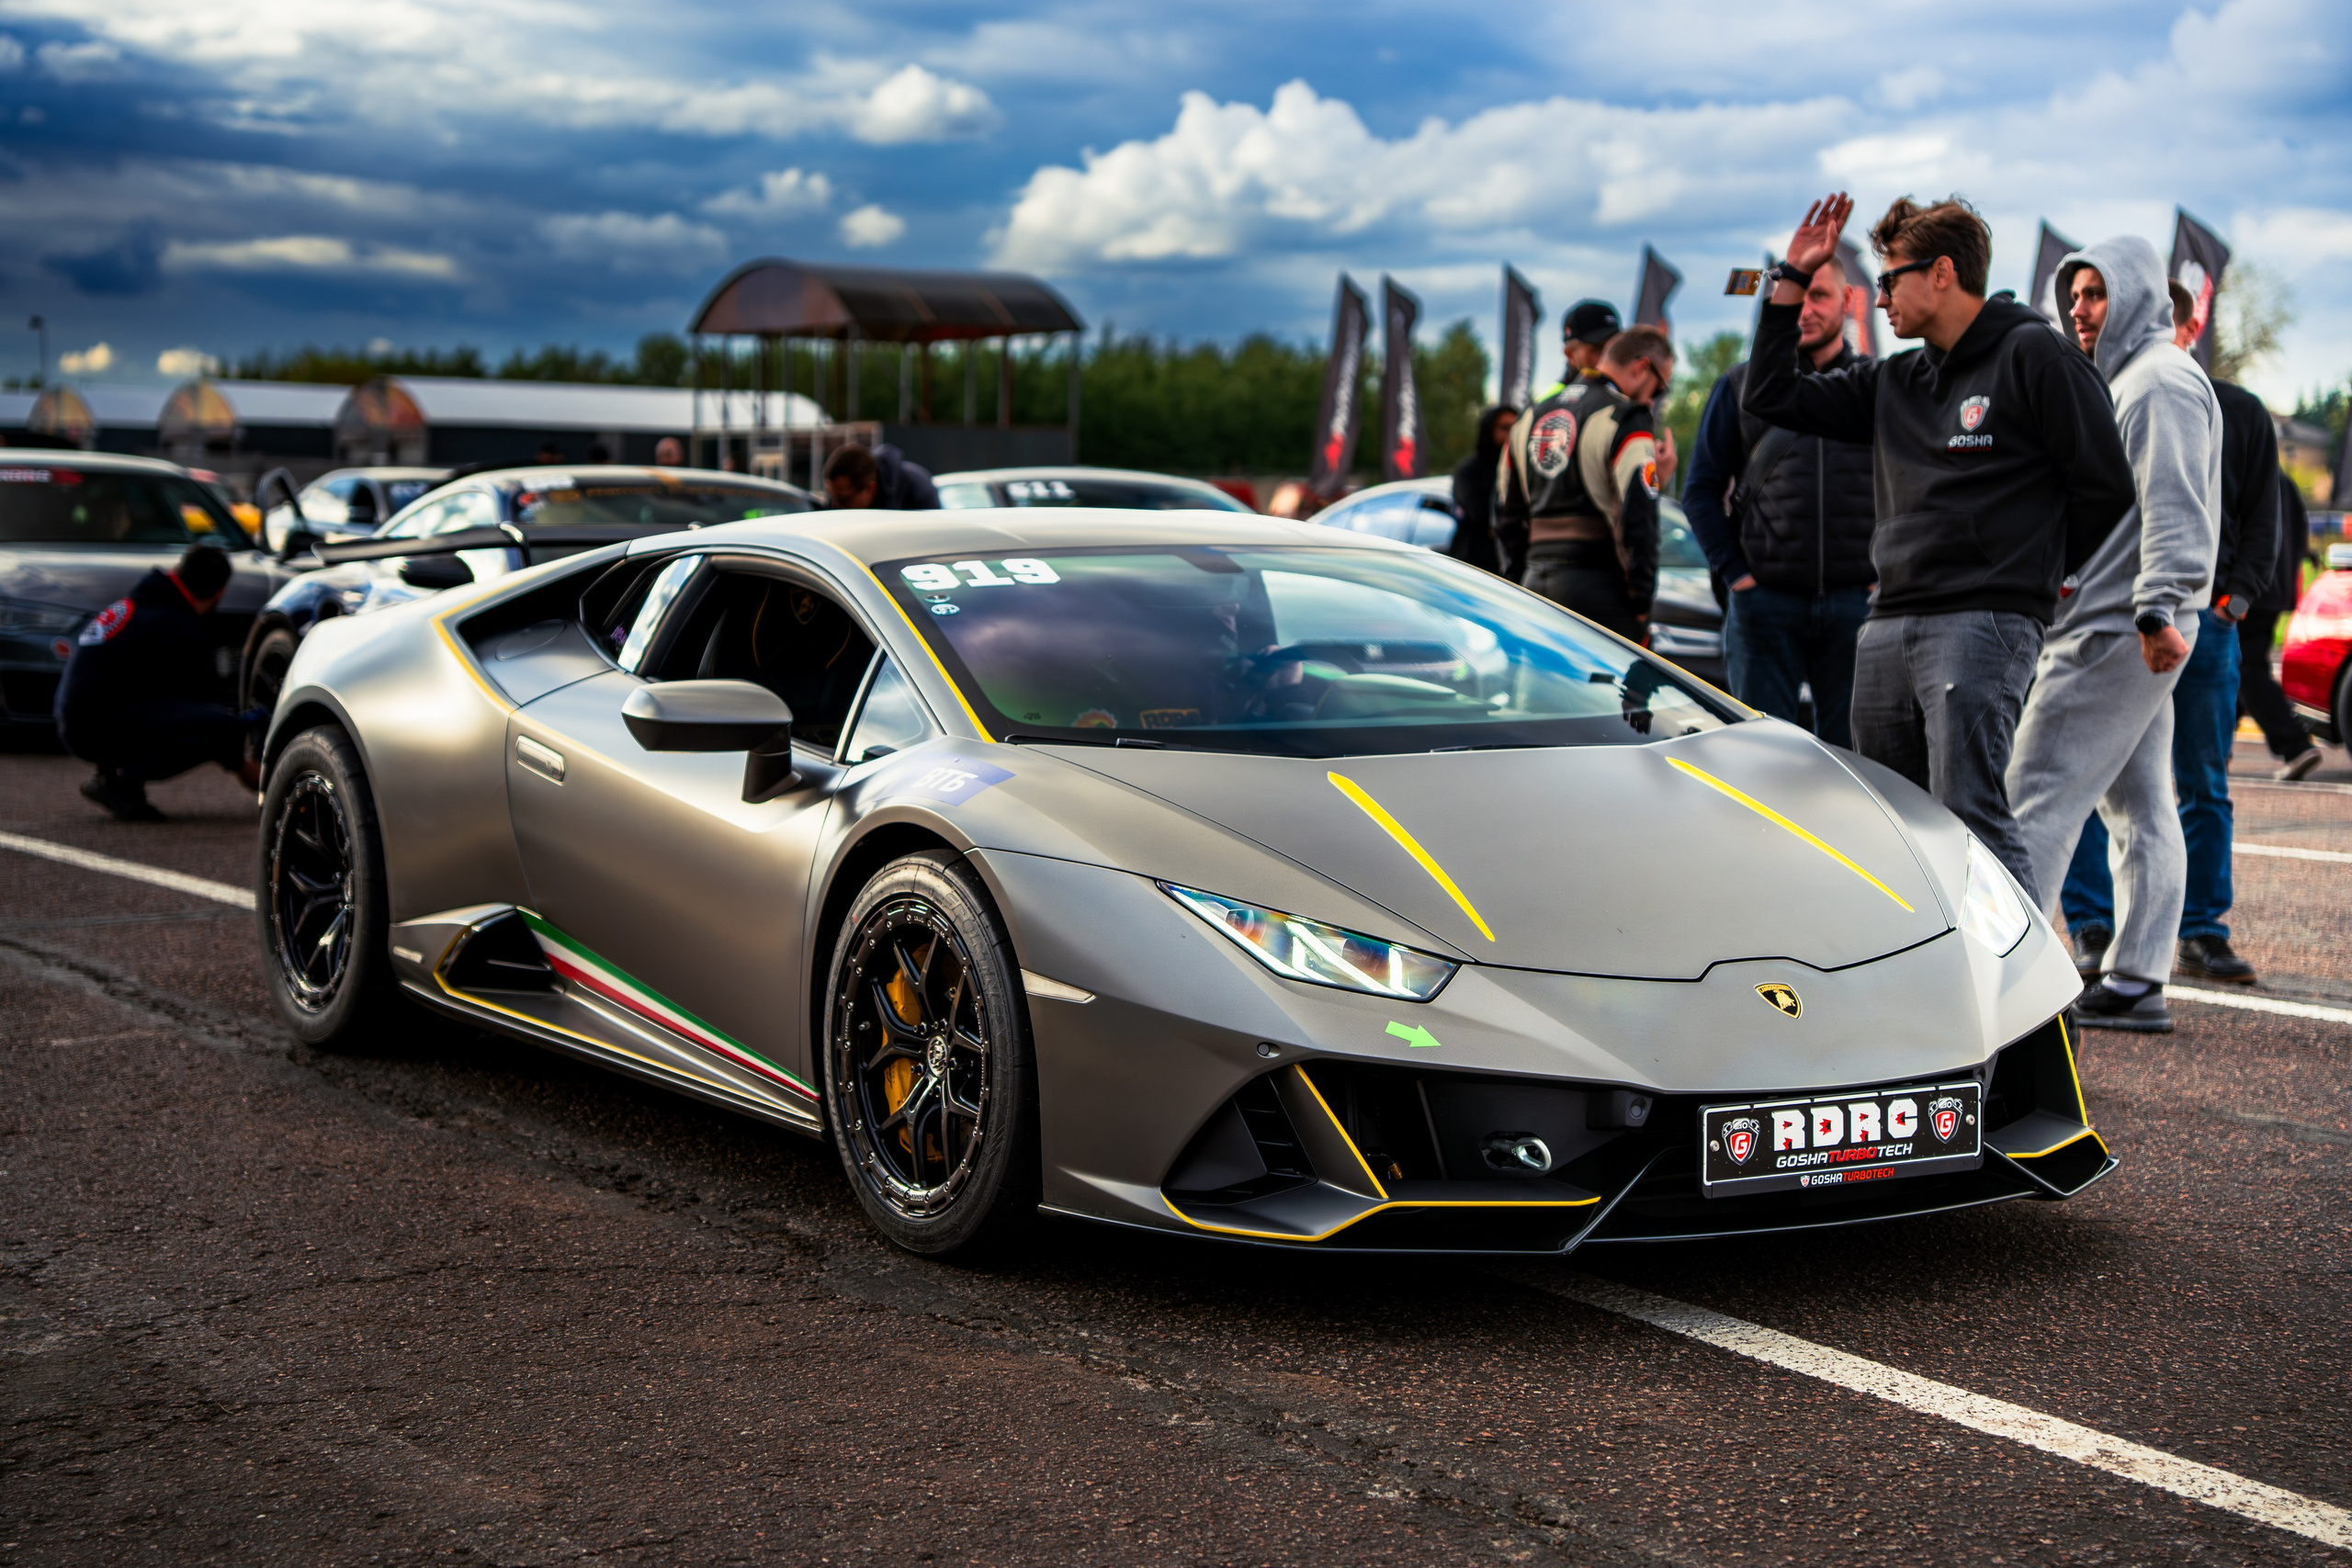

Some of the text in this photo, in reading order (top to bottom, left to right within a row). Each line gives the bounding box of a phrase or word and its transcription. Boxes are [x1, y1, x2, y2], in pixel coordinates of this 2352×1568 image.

[1948, 434, 1993, 447] GOSHA
[900, 558, 1061, 591] 919
[1771, 1098, 1918, 1152] RDRC
[1776, 1143, 1914, 1168] GOSHATURBOTECH
[1811, 1168, 1894, 1186] GOSHATURBOTECH
